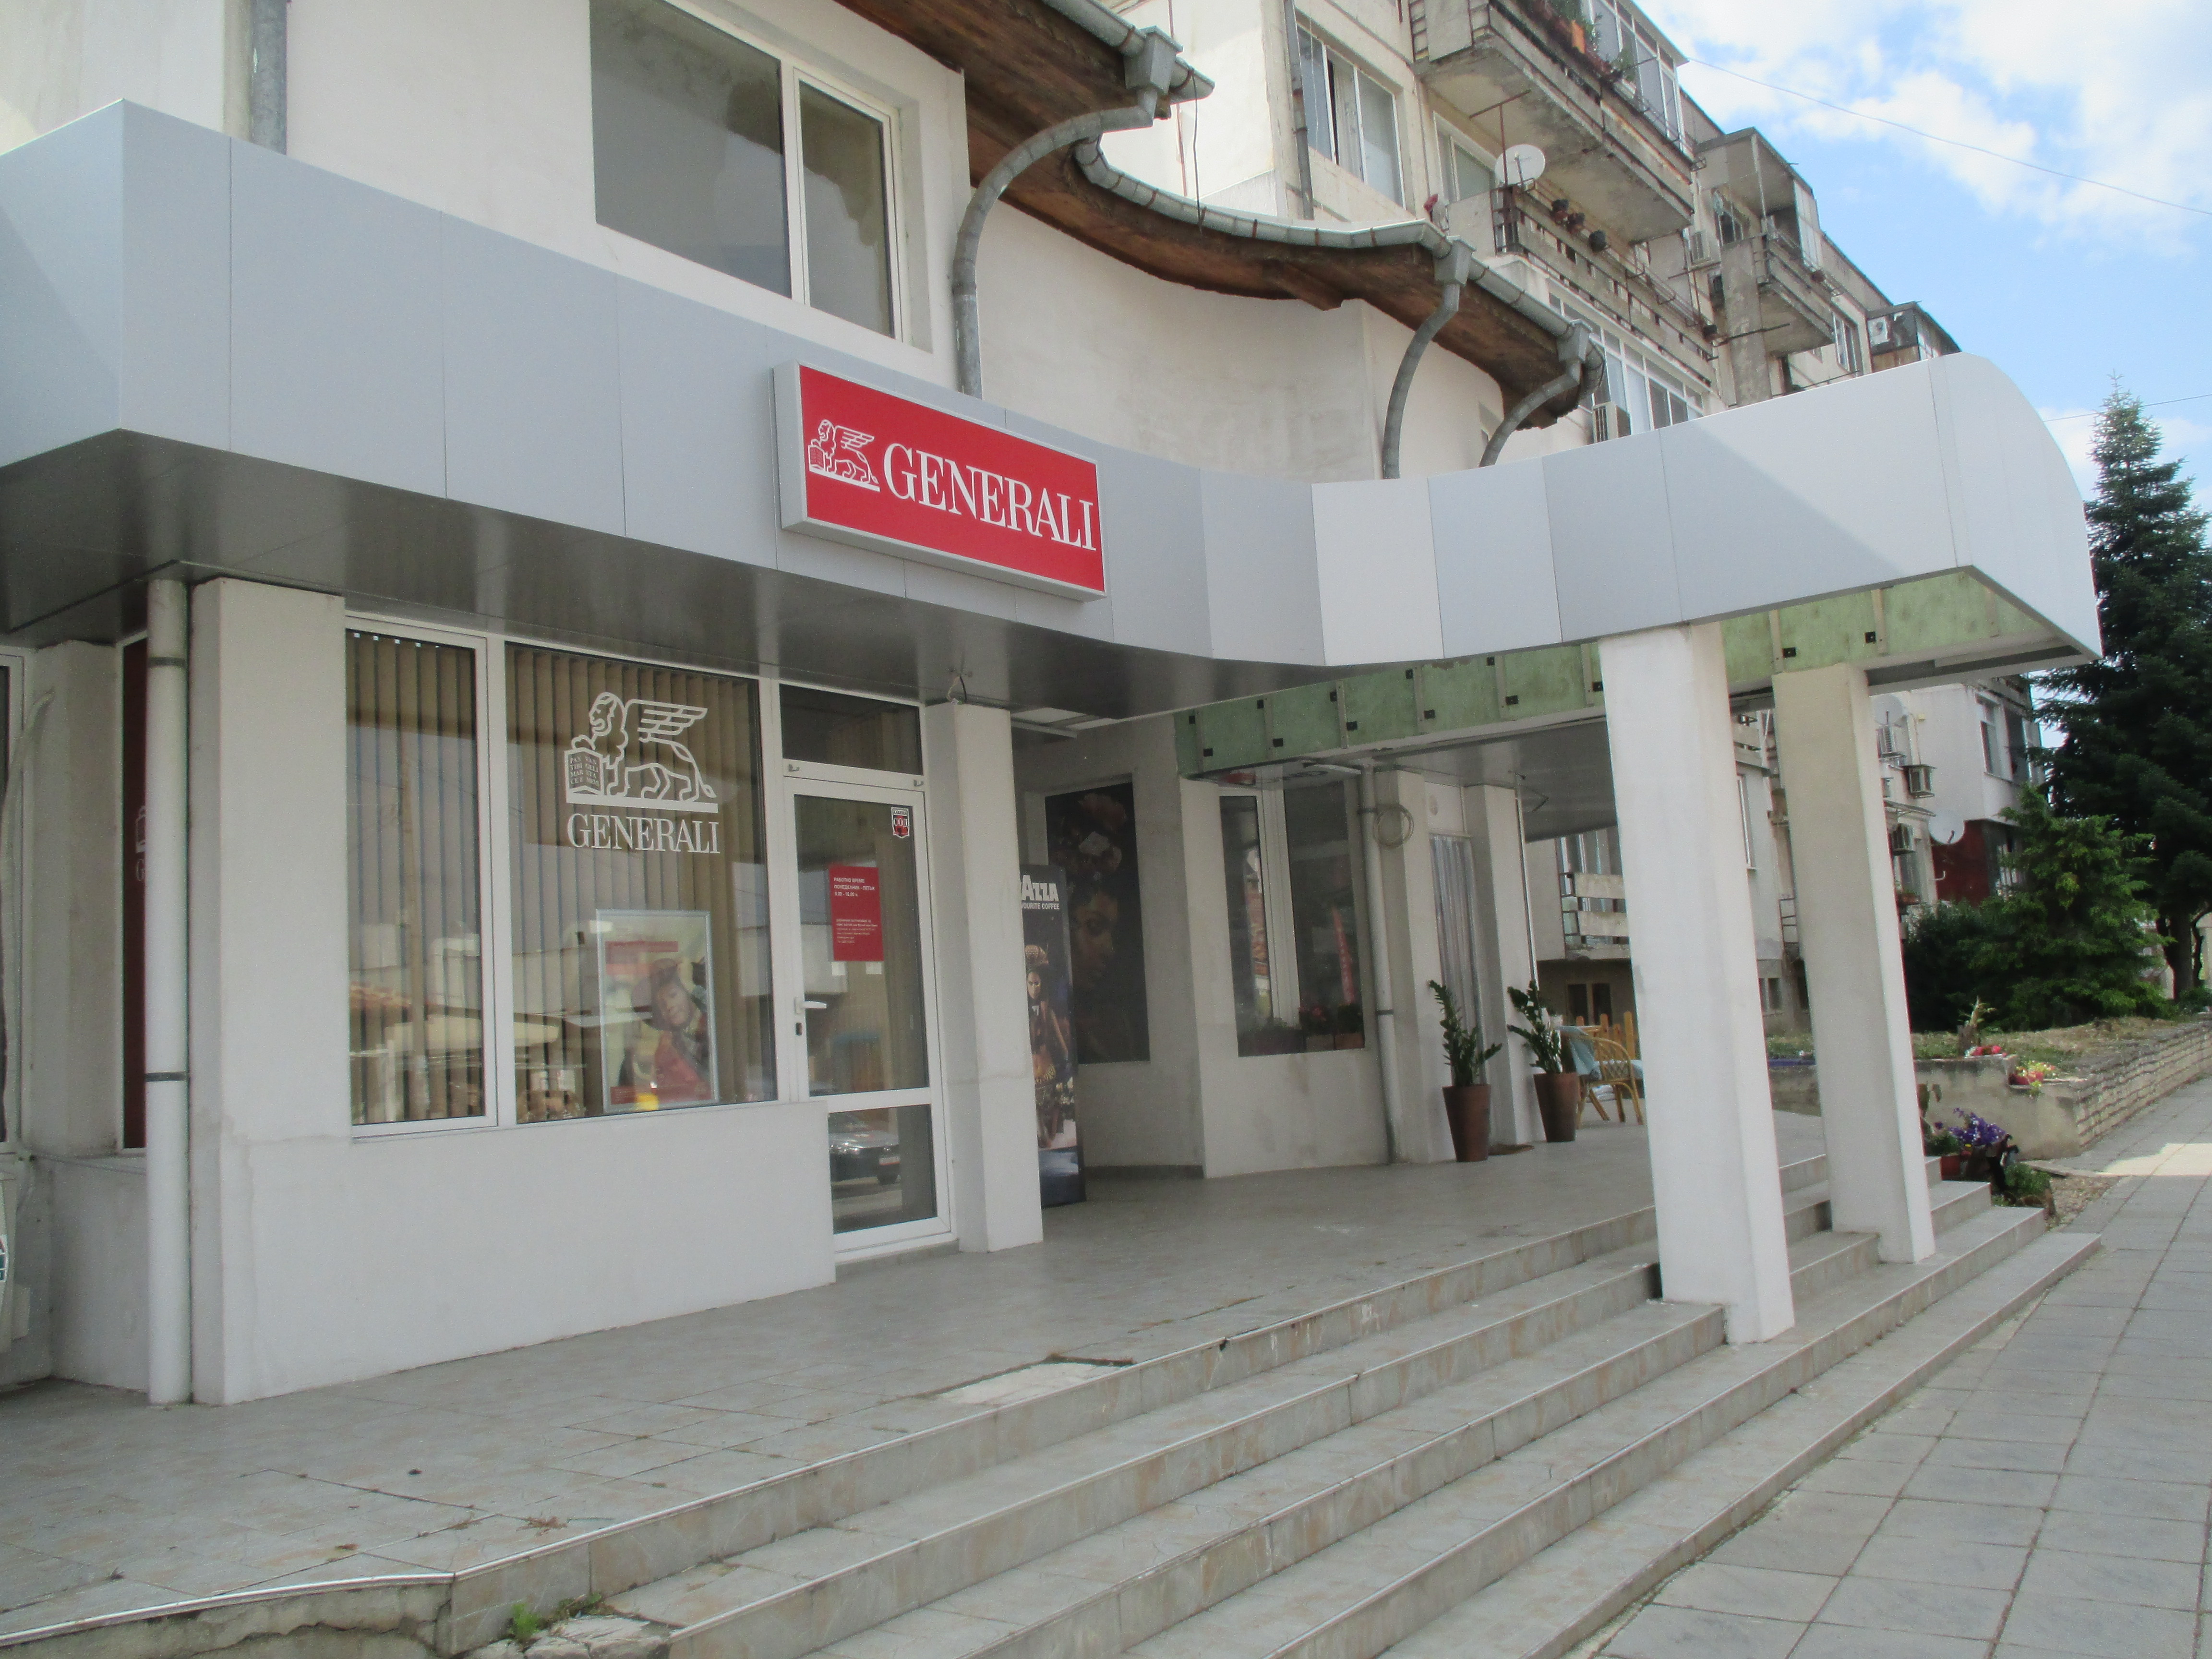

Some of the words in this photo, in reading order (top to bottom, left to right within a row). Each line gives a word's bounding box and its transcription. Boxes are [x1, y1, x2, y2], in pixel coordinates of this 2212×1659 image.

[883, 443, 1096, 551] GENERALI
[566, 813, 720, 854] GENERALI
[1021, 875, 1059, 902] AZZA
